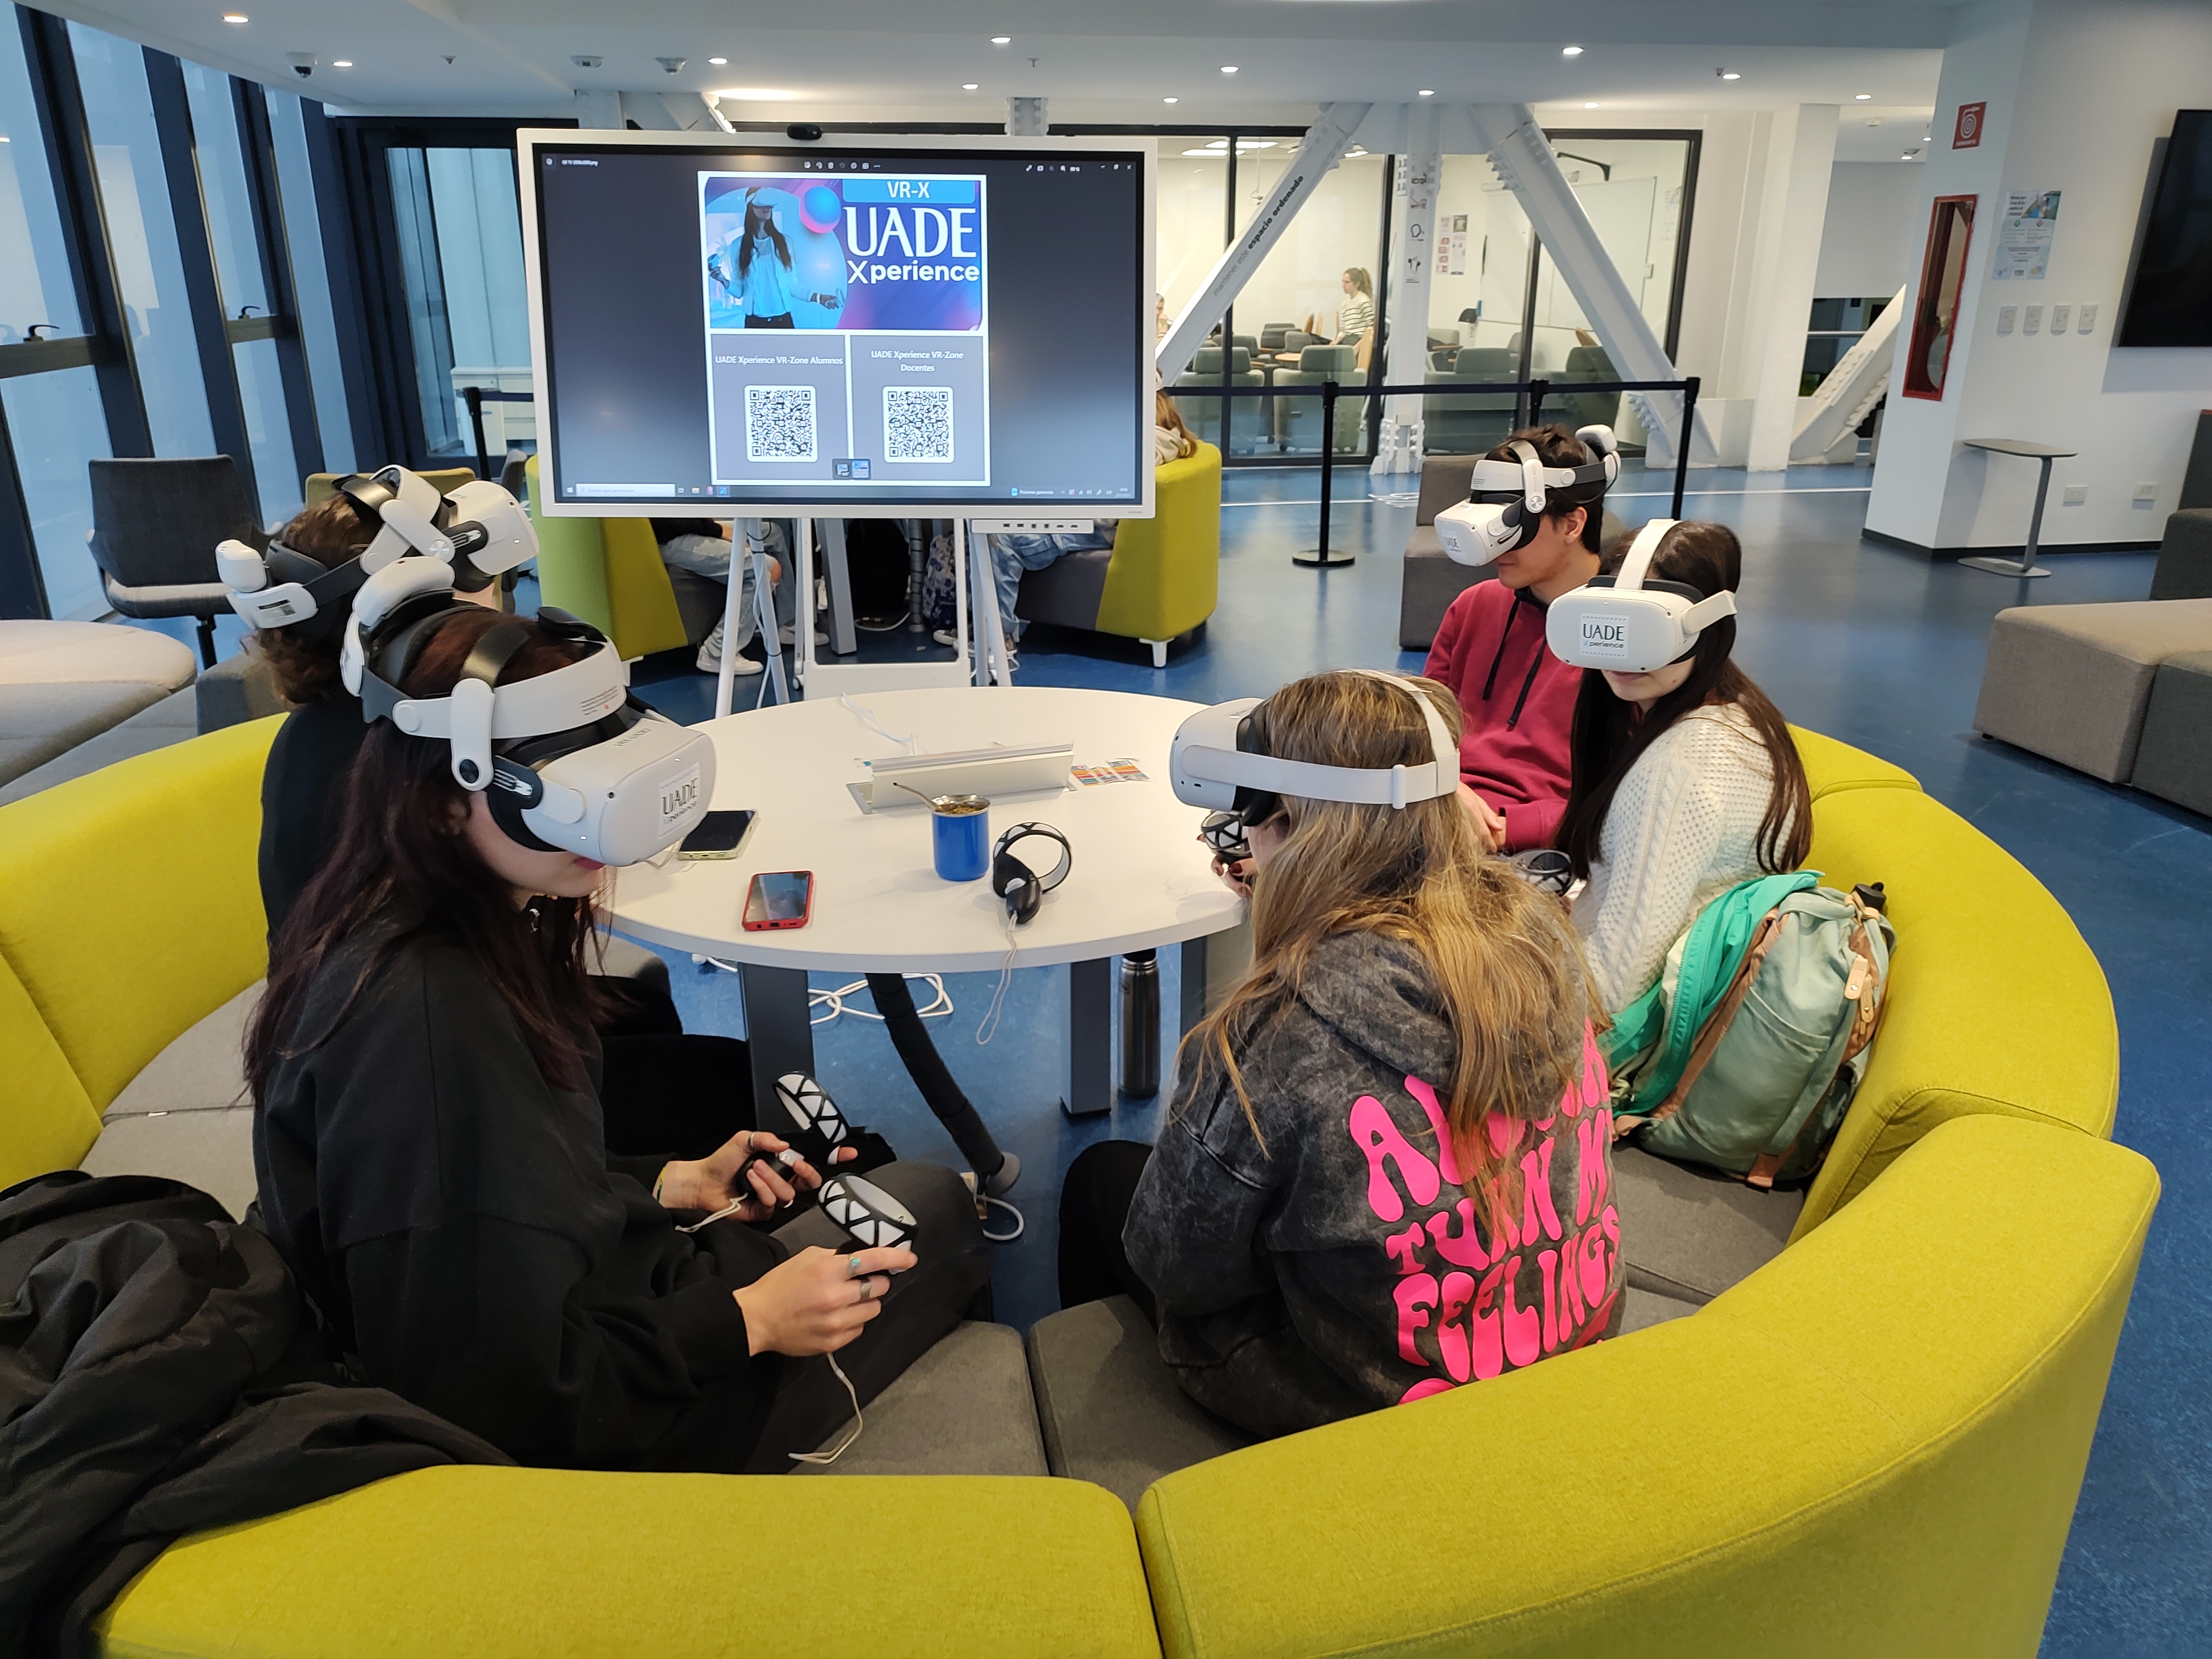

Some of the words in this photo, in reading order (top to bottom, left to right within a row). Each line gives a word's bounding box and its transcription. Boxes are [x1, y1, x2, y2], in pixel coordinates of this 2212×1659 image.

[887, 181, 930, 199] VR-X
[1237, 249, 1250, 264] este
[1248, 217, 1272, 249] espacio
[1272, 175, 1304, 216] ordenado
[843, 207, 977, 258] UADE
[847, 259, 980, 284] Xperience
[715, 355, 737, 364] UADE
[737, 356, 775, 366] Xperience
[776, 356, 809, 364] VR-Zone
[810, 356, 843, 365] Alumnos
[871, 350, 893, 358] UADE
[893, 350, 931, 360] Xperience
[931, 351, 964, 359] VR-Zone
[900, 363, 935, 372] Docentes
[1583, 623, 1625, 641] UADE
[661, 778, 698, 815] UADE
